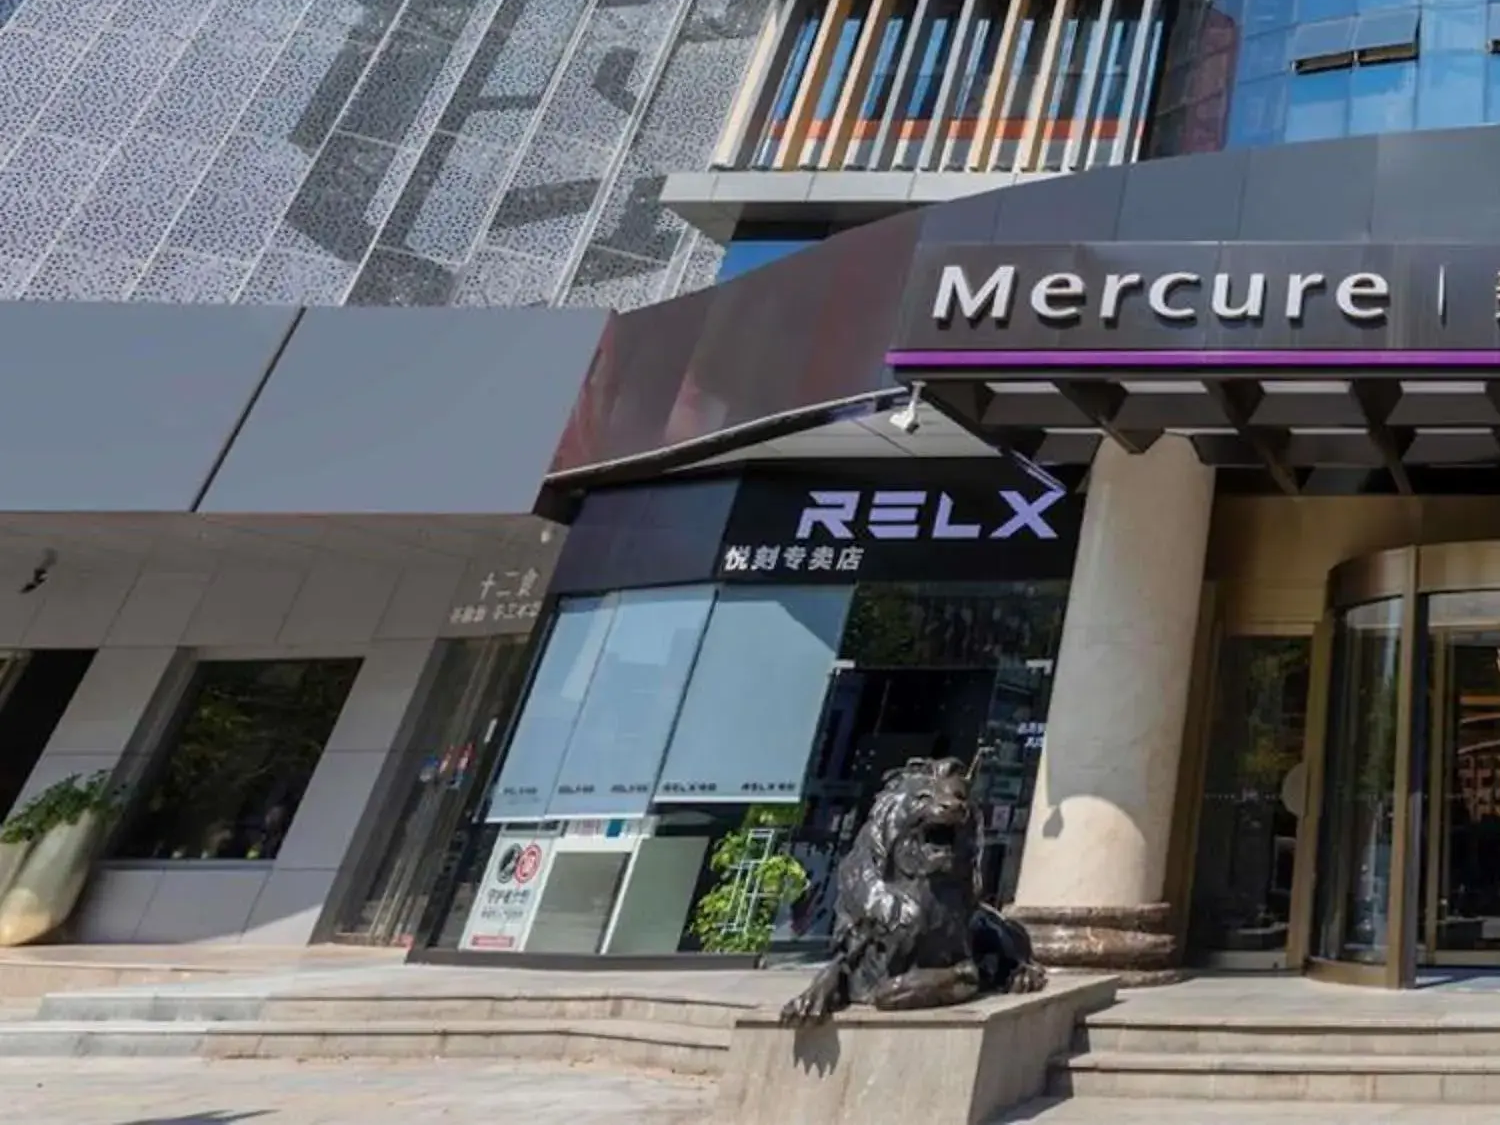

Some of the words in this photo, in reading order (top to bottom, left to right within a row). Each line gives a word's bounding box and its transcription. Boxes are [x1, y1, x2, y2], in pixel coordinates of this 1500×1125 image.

[932, 265, 1388, 320] Mercure
[795, 490, 1066, 540] RELX
[724, 544, 865, 571] 悦刻专卖店
